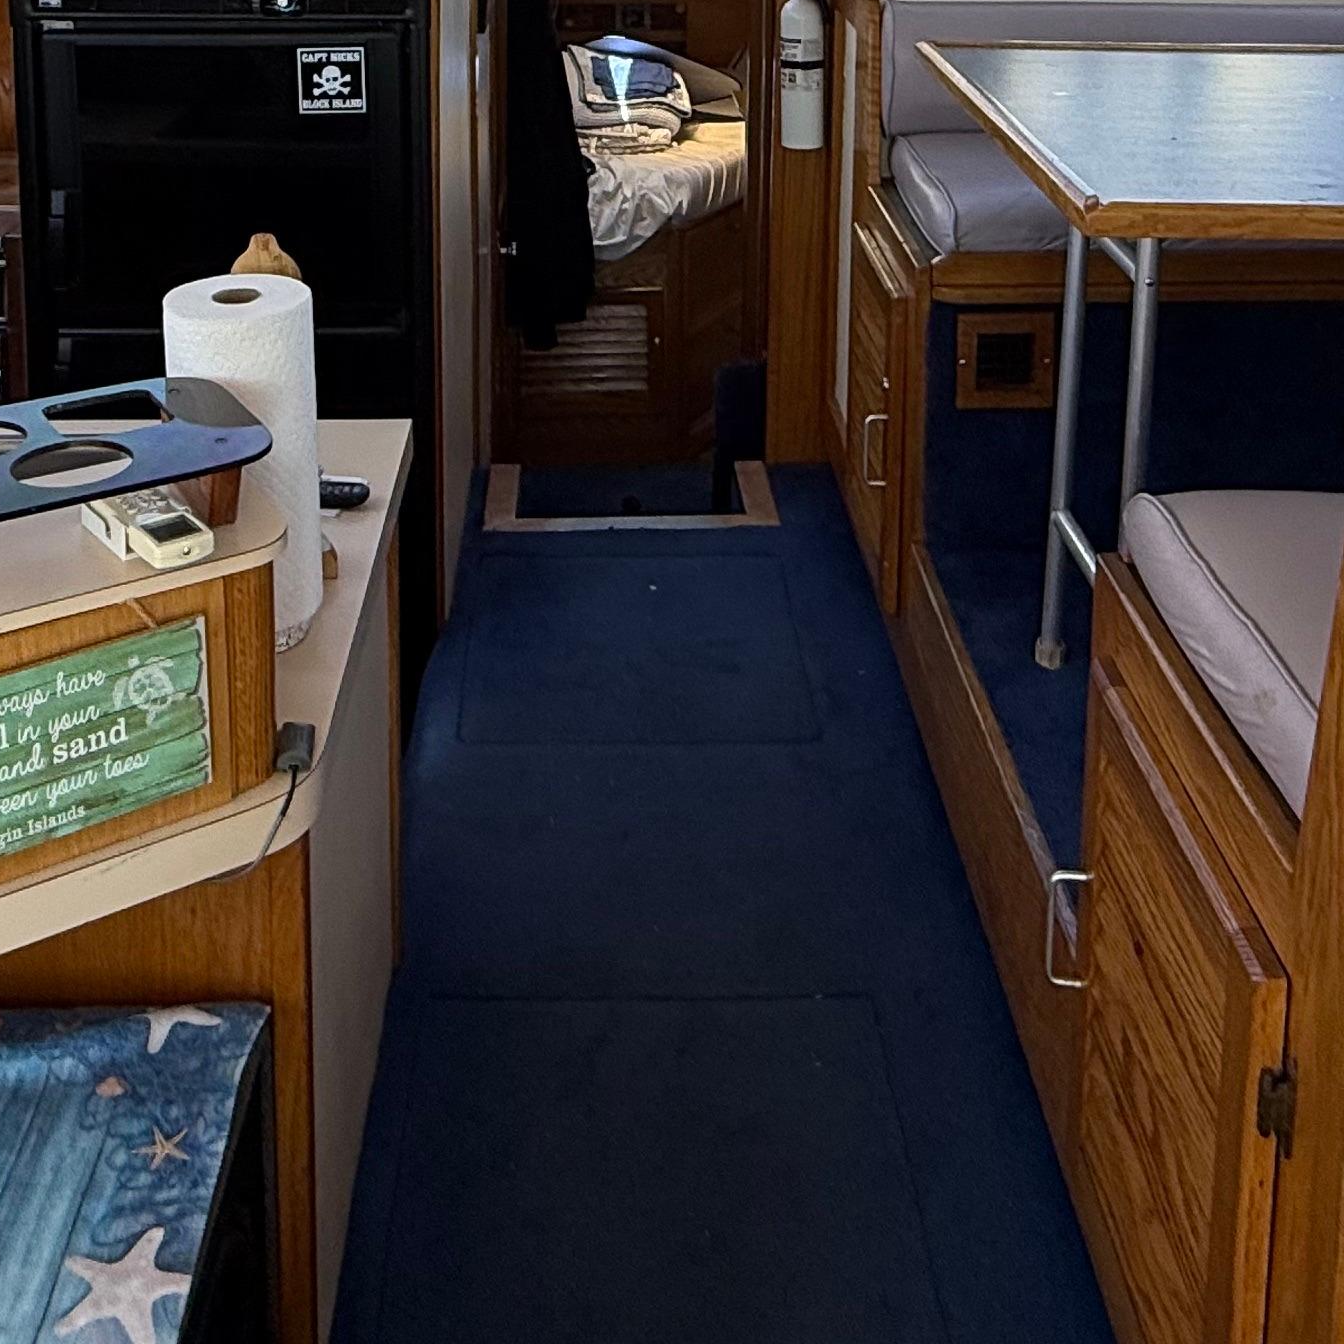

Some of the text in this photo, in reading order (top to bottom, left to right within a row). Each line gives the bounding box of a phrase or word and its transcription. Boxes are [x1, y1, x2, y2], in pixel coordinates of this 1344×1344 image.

[332, 98, 363, 108] ISLAND
[56, 669, 106, 698] have
[17, 720, 41, 744] in
[48, 705, 100, 743] your
[53, 717, 129, 764] sand
[46, 768, 98, 807] your
[103, 753, 149, 779] toes
[27, 805, 86, 835] Islands
